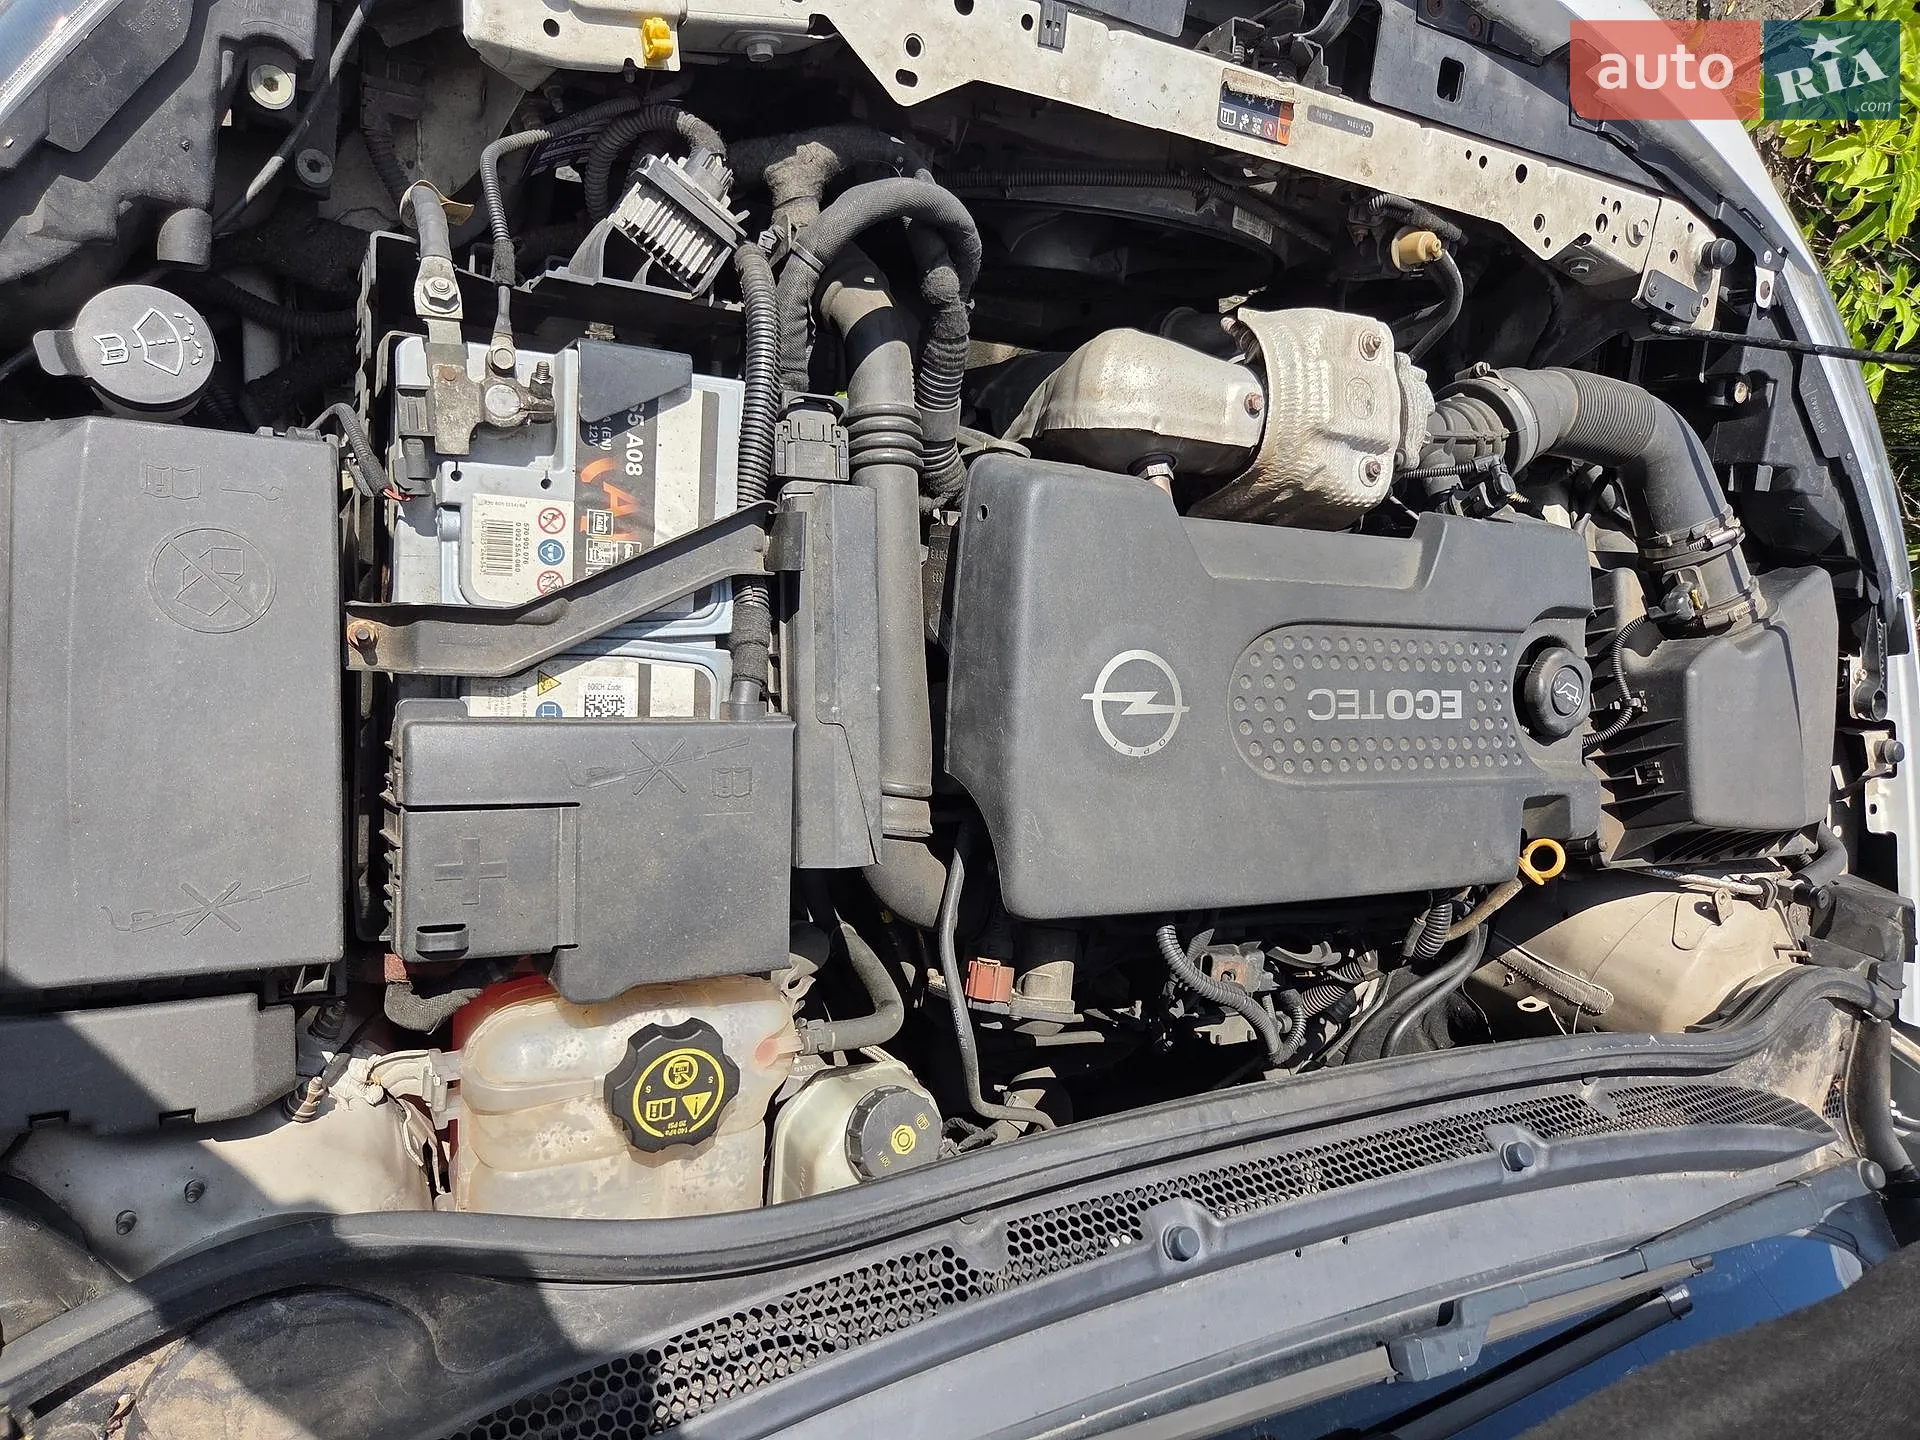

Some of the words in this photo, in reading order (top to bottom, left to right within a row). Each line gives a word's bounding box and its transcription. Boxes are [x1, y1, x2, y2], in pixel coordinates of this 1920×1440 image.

[588, 424, 599, 447] 12V
[599, 426, 612, 451] (EN)
[625, 432, 644, 476] A08
[1307, 688, 1463, 721] ECOTEC
[1112, 739, 1166, 755] OPEL
[678, 1127, 688, 1135] 140
